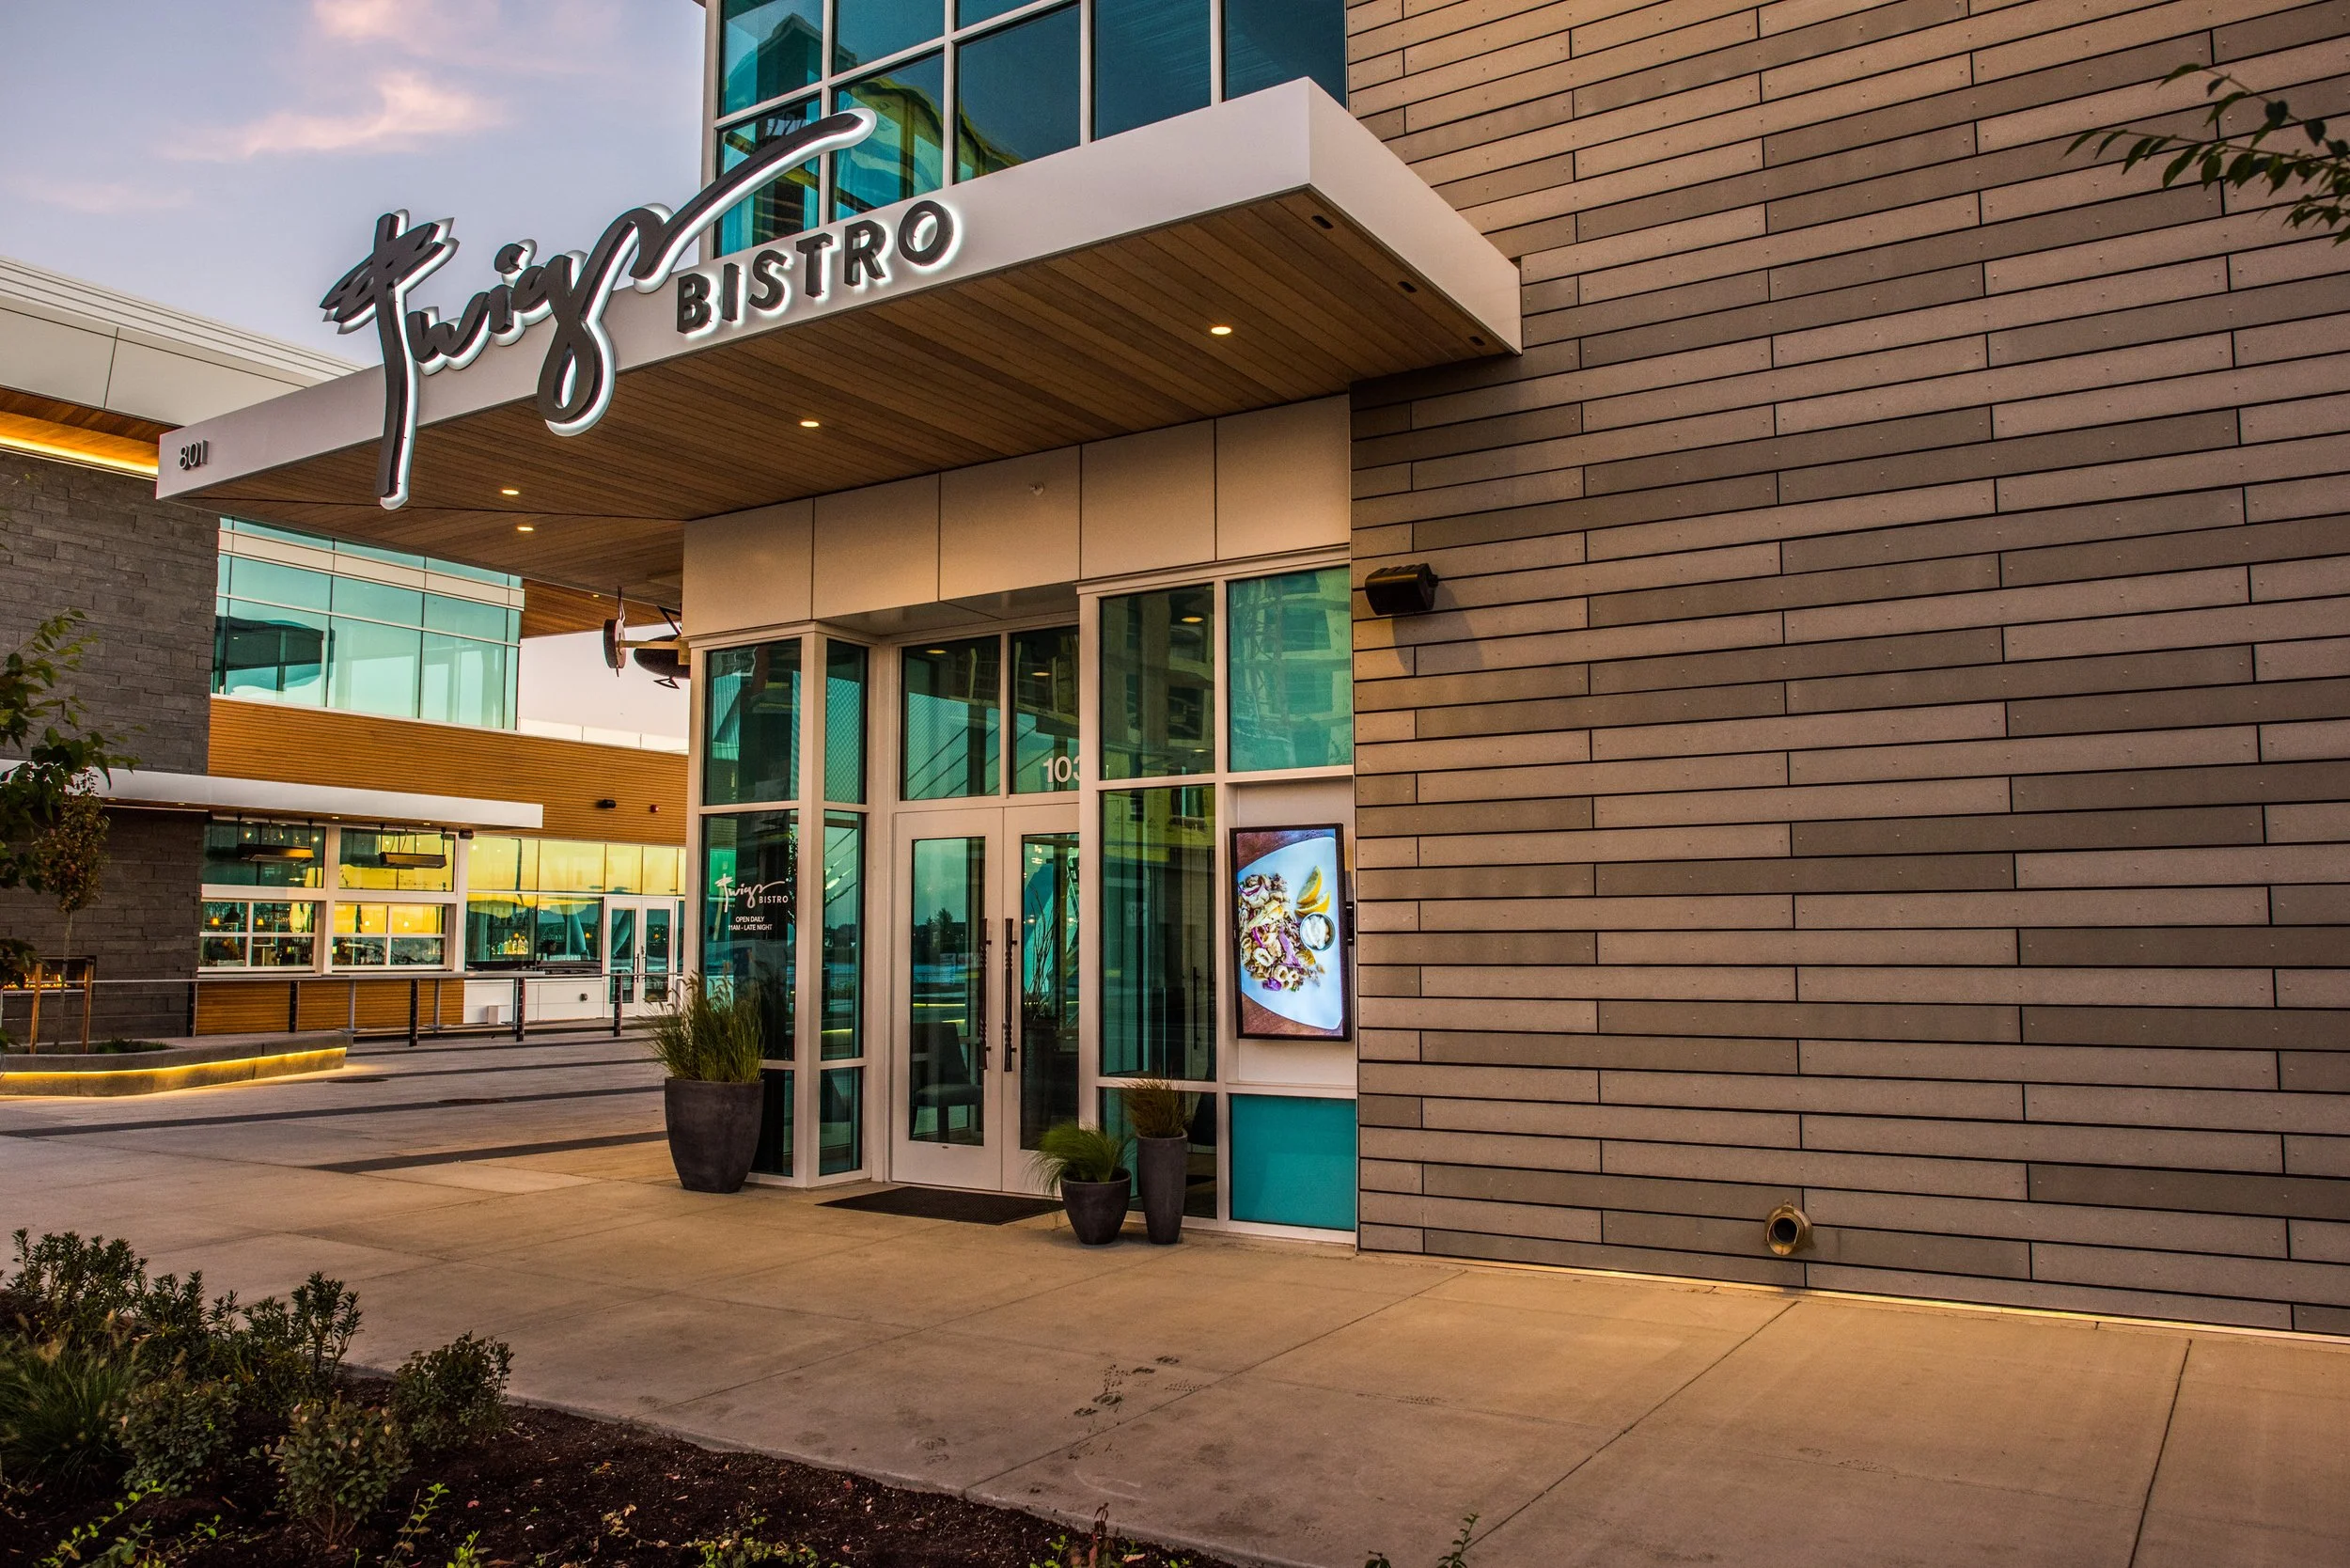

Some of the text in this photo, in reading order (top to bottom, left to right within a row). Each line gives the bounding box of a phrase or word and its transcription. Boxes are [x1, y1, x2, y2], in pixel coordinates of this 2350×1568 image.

[676, 199, 956, 335] BISTRO
[179, 439, 209, 471] 801
[759, 895, 789, 904] BISTRO
